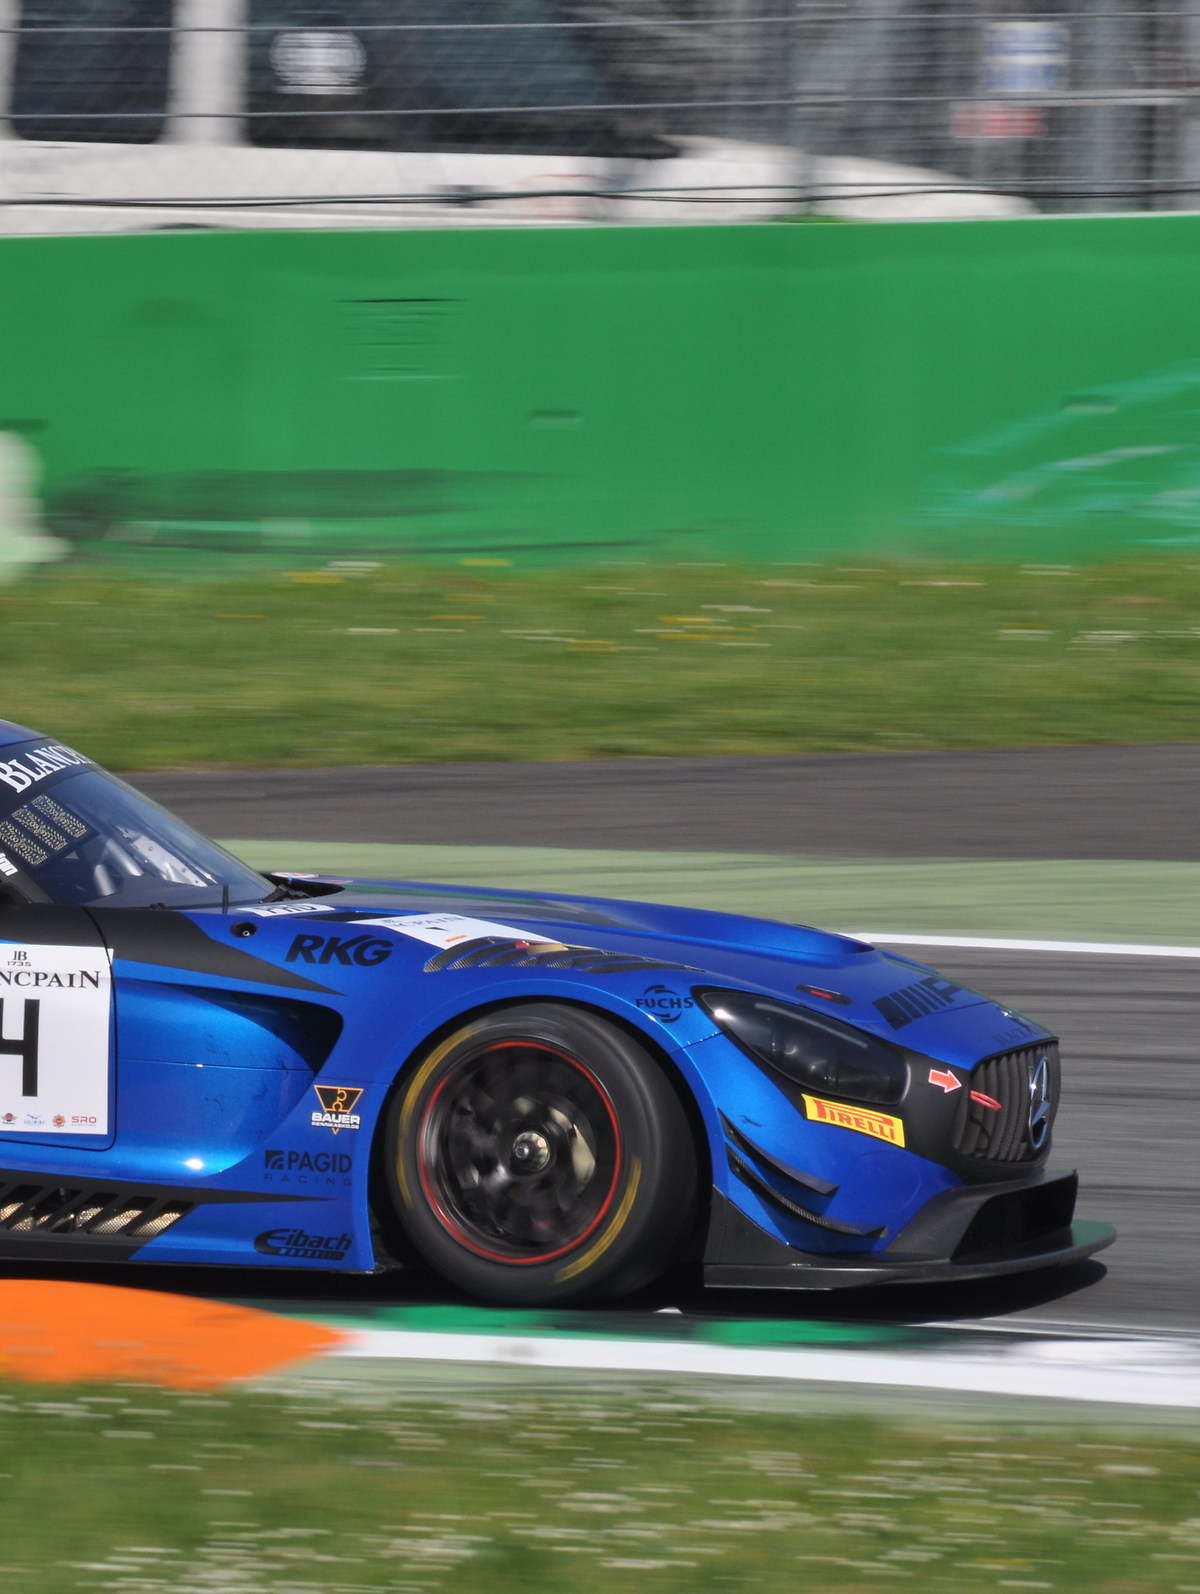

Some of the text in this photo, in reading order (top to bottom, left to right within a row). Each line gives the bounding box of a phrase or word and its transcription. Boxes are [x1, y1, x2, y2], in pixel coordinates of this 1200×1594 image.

[284, 934, 395, 967] RKG
[635, 997, 695, 1009] FUCHS
[71, 1115, 97, 1124] SRO
[311, 1112, 360, 1125] BAUER
[812, 1098, 896, 1141] PIRELLI
[287, 1151, 353, 1174] PAGID
[264, 1173, 353, 1185] RACING
[254, 1228, 353, 1261] Eibach
